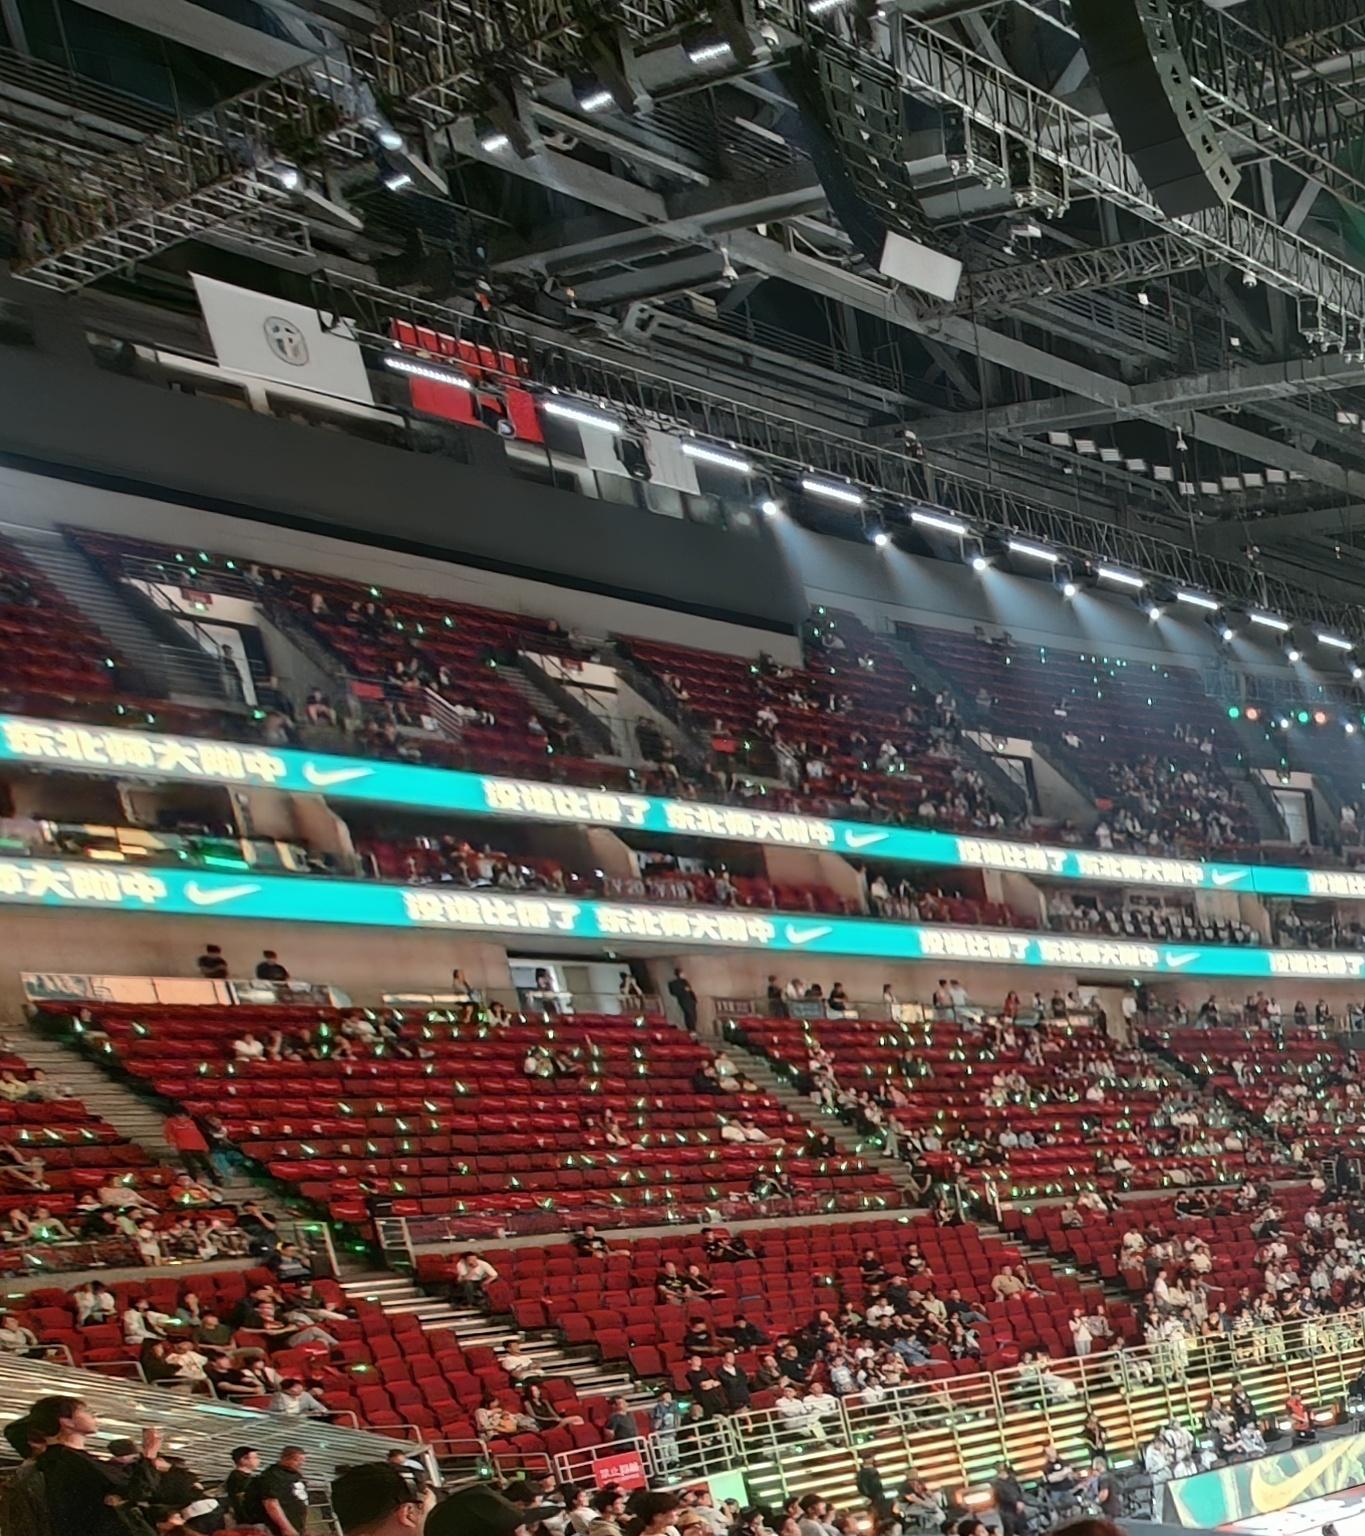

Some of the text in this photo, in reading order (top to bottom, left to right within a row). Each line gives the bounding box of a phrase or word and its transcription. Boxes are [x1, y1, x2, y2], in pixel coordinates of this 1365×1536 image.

[4, 719, 286, 782] 东北师大附中
[483, 780, 835, 846] 没谁比得了 东北师大附中
[405, 892, 775, 944] 没谁比得了 东北师大附中
